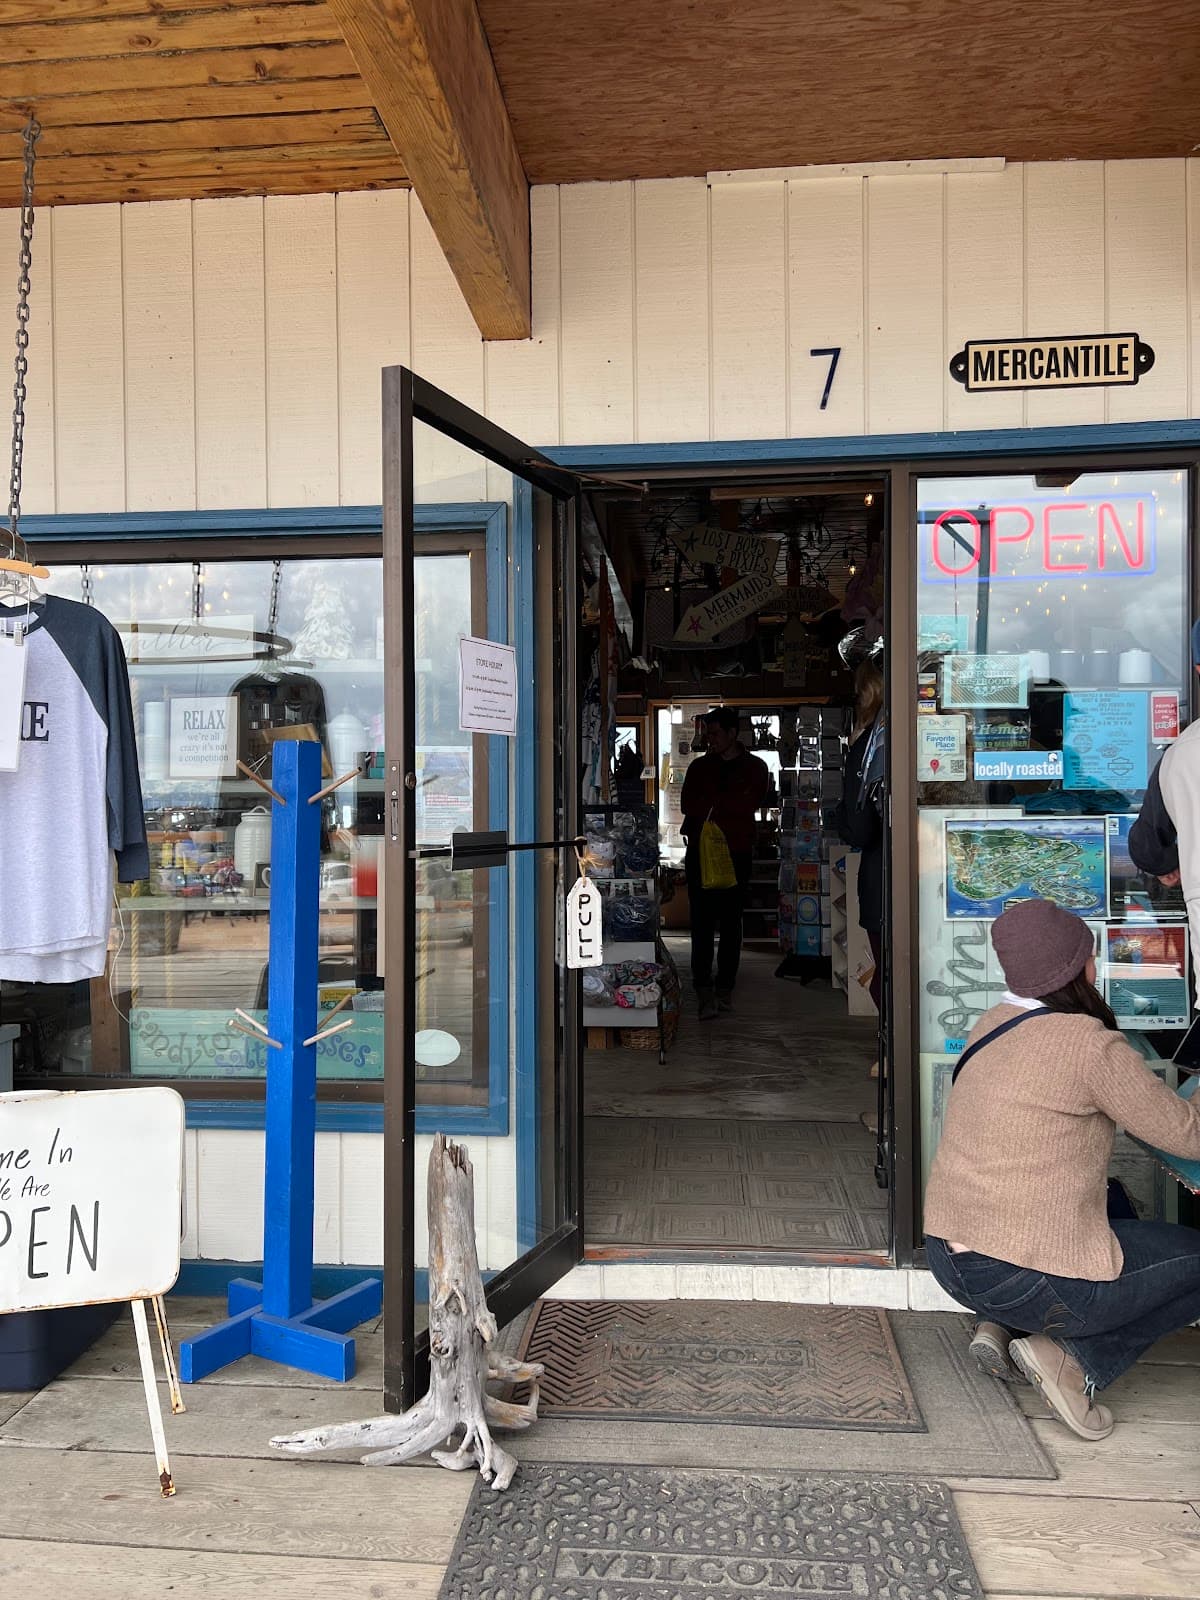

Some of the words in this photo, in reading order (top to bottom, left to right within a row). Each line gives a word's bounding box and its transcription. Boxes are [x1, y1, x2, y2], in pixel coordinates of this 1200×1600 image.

[972, 343, 1130, 382] MERCANTILE
[809, 347, 841, 410] 7
[702, 529, 731, 549] LOST
[735, 535, 766, 557] BOYS
[932, 501, 1145, 575] OPEN
[716, 548, 724, 564] &
[729, 550, 770, 574] PIXIES
[703, 575, 773, 621] MERMAIDS
[183, 709, 226, 730] RELAX
[979, 723, 1024, 735] Homer
[180, 744, 199, 753] crazy
[215, 744, 228, 752] not
[187, 731, 209, 741] we're
[210, 731, 220, 741] all
[184, 753, 229, 764] competition
[975, 761, 1013, 778] locally
[1016, 760, 1063, 776] roasted
[578, 893, 593, 958] PULL
[47, 1127, 73, 1165] In
[21, 1175, 51, 1198] Are
[571, 1551, 851, 1589] WELCOME
